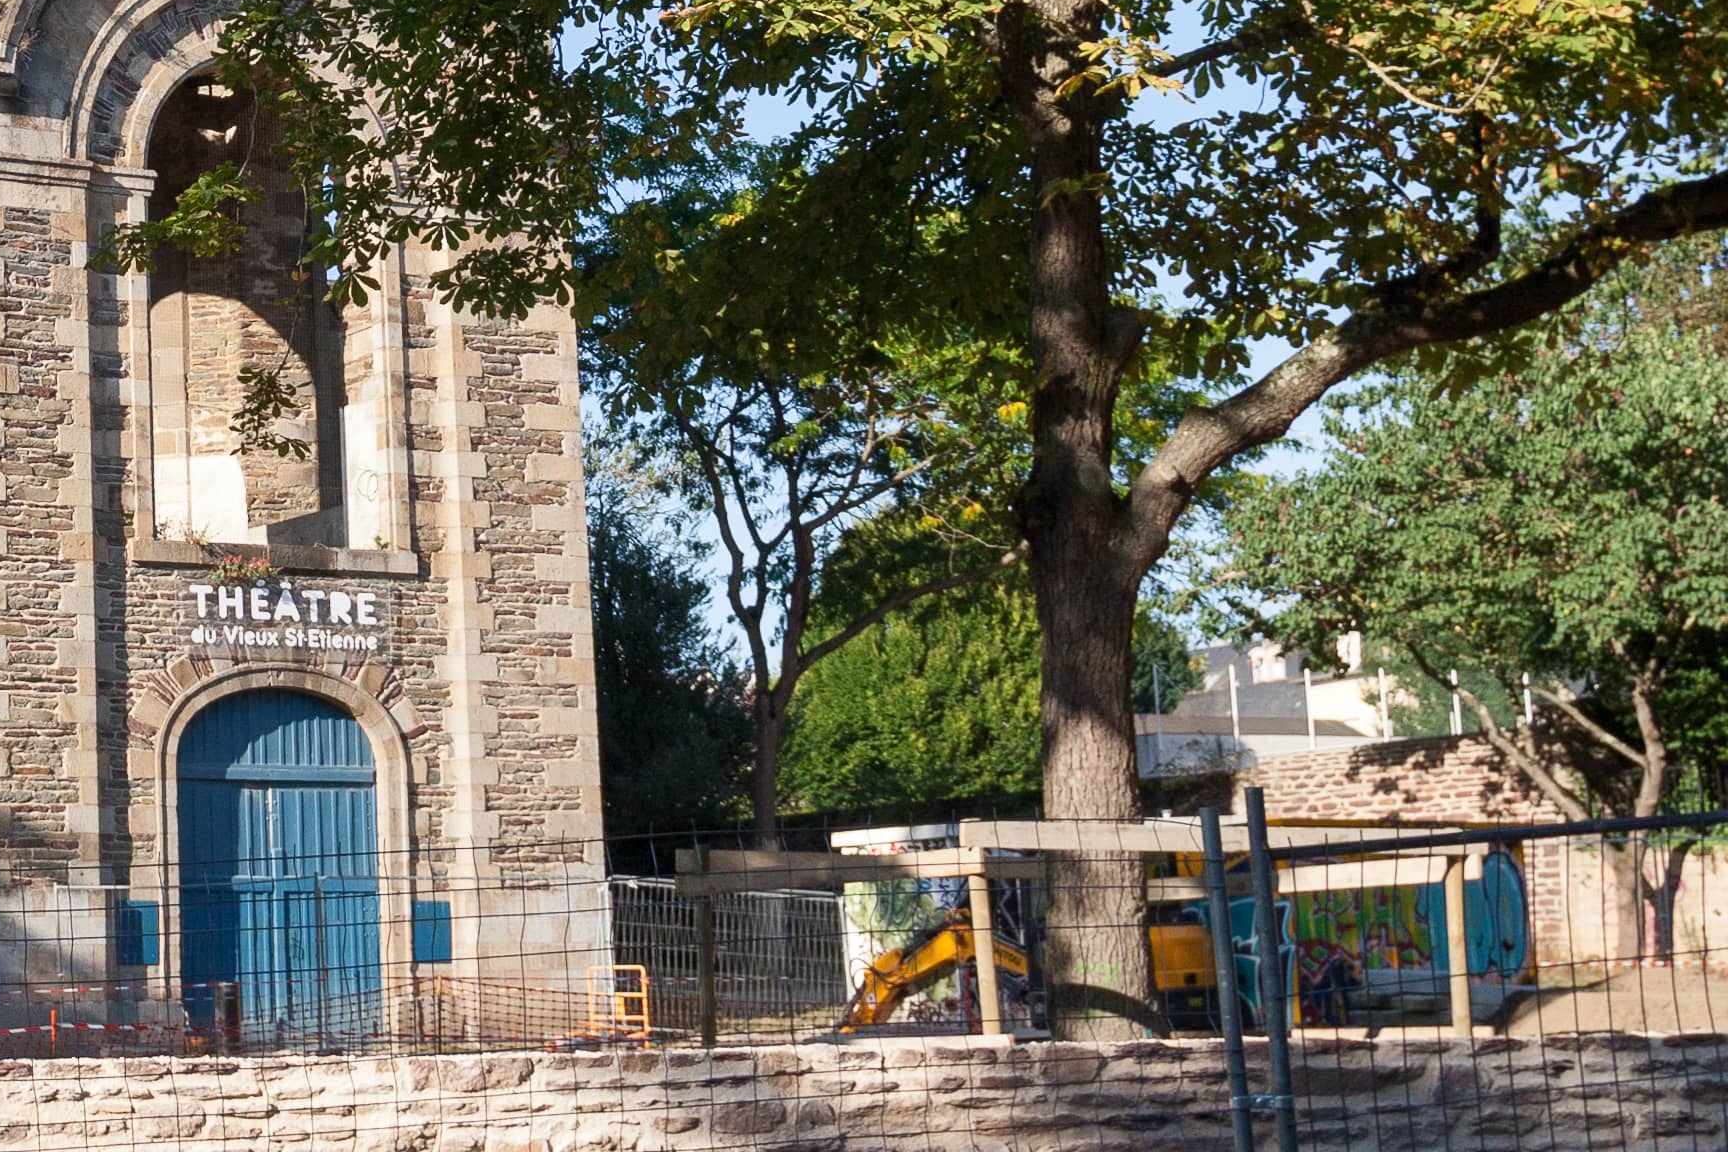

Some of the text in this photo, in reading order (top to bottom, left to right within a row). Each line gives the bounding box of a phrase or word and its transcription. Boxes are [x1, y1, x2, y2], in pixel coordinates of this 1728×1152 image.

[189, 580, 378, 626] THÉÂTRE
[190, 624, 217, 644] du
[223, 625, 279, 647] Vieux
